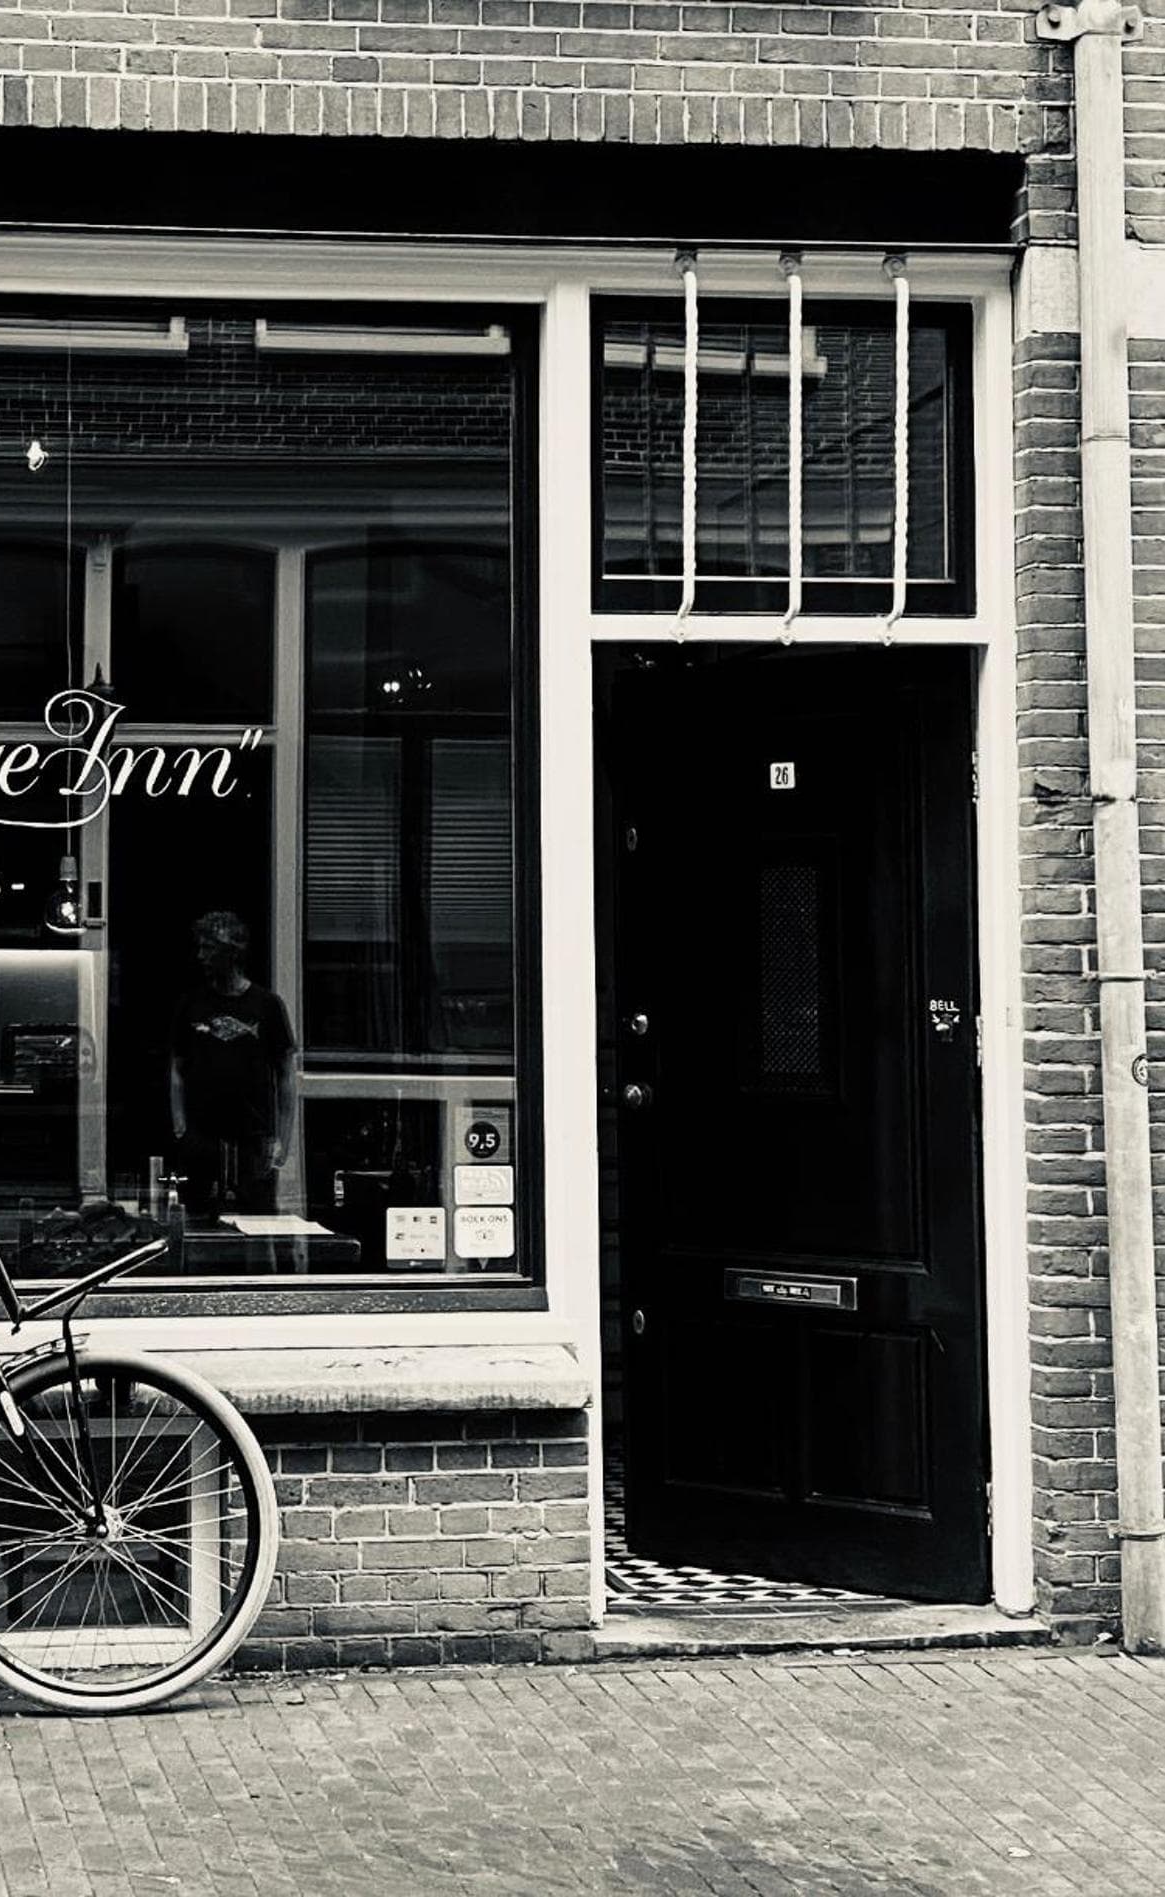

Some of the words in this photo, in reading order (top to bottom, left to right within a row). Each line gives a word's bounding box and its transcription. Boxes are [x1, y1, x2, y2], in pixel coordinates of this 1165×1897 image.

[775, 766, 789, 785] 26
[929, 999, 960, 1012] BELL
[468, 1133, 496, 1150] 9,5
